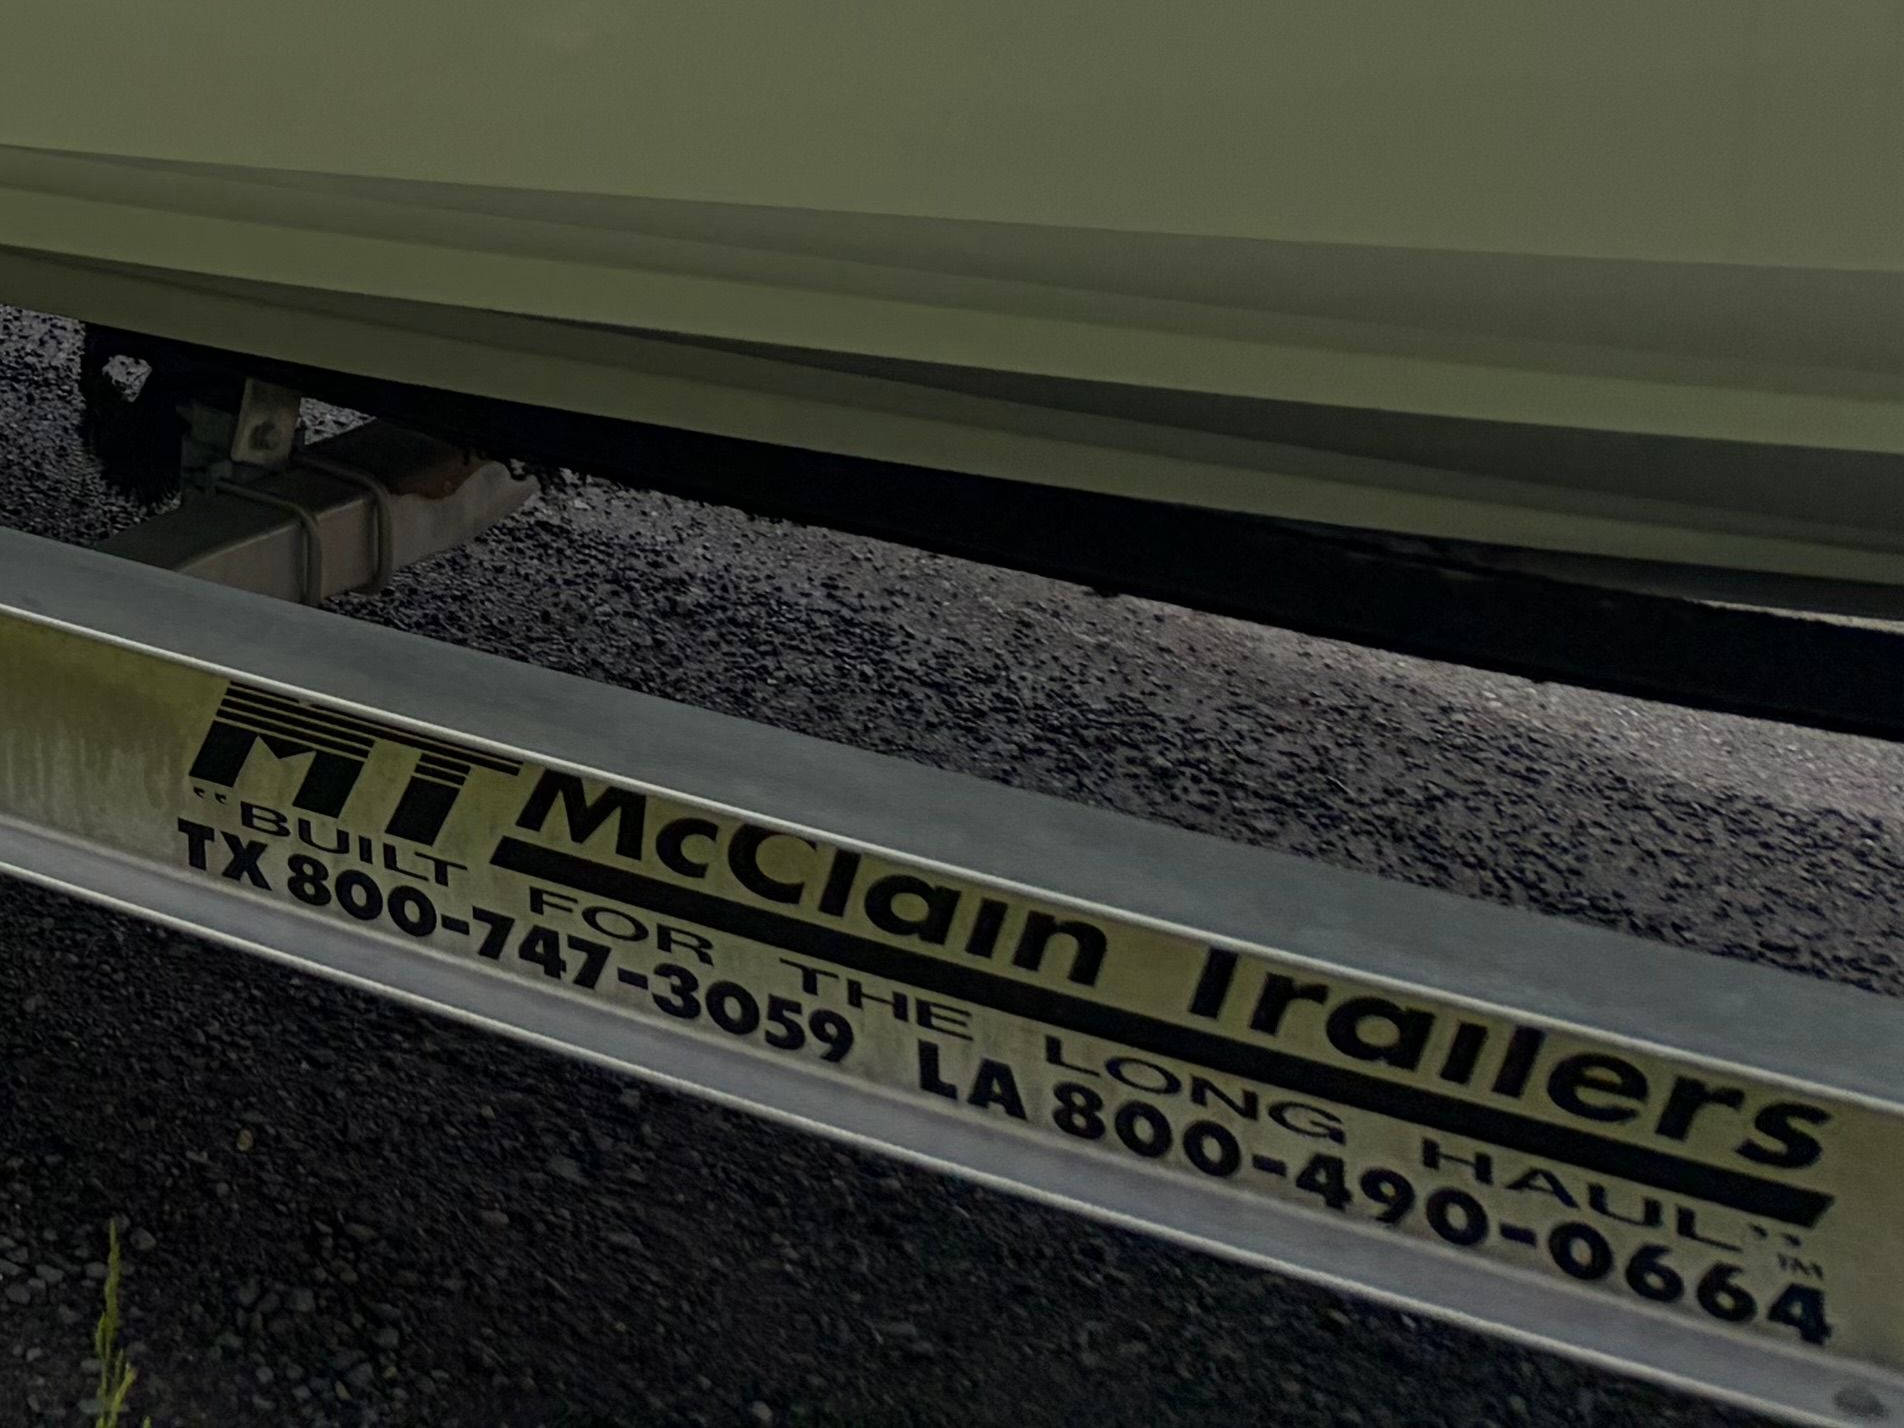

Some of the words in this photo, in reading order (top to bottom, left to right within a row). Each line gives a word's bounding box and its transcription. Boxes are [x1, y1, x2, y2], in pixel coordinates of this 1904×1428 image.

[515, 768, 1109, 987] McClain
[177, 817, 272, 891] TX
[287, 854, 855, 1064] 800-747-3059
[918, 1039, 1027, 1120] LA
[1052, 1082, 1832, 1345] 800-490-0664
[529, 886, 715, 967] FOR
[779, 957, 973, 1041] THE
[1044, 1035, 1346, 1146] LONG
